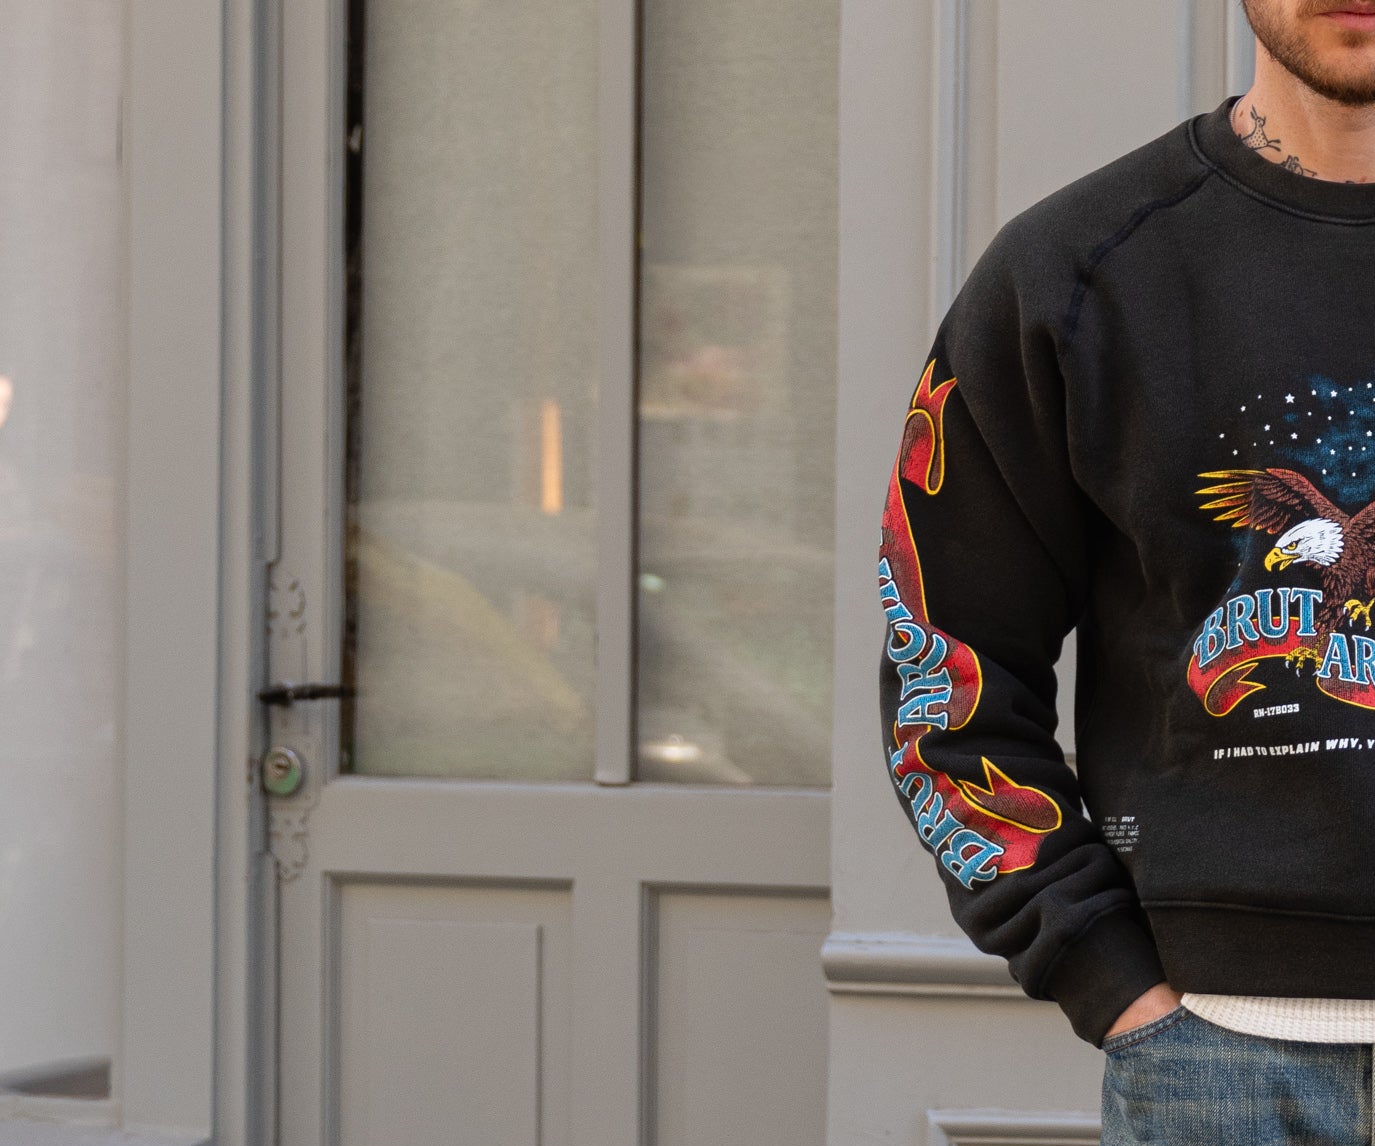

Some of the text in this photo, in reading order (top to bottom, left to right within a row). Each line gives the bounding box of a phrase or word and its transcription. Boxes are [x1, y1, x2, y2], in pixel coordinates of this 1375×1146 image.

[1193, 587, 1323, 668] BRUT
[1214, 749, 1225, 759] IF
[1227, 748, 1231, 758] I
[1233, 747, 1254, 757] HAD
[1256, 746, 1268, 756] TO
[1270, 741, 1320, 756] EXPLAIN
[1326, 738, 1363, 750] WHY,
